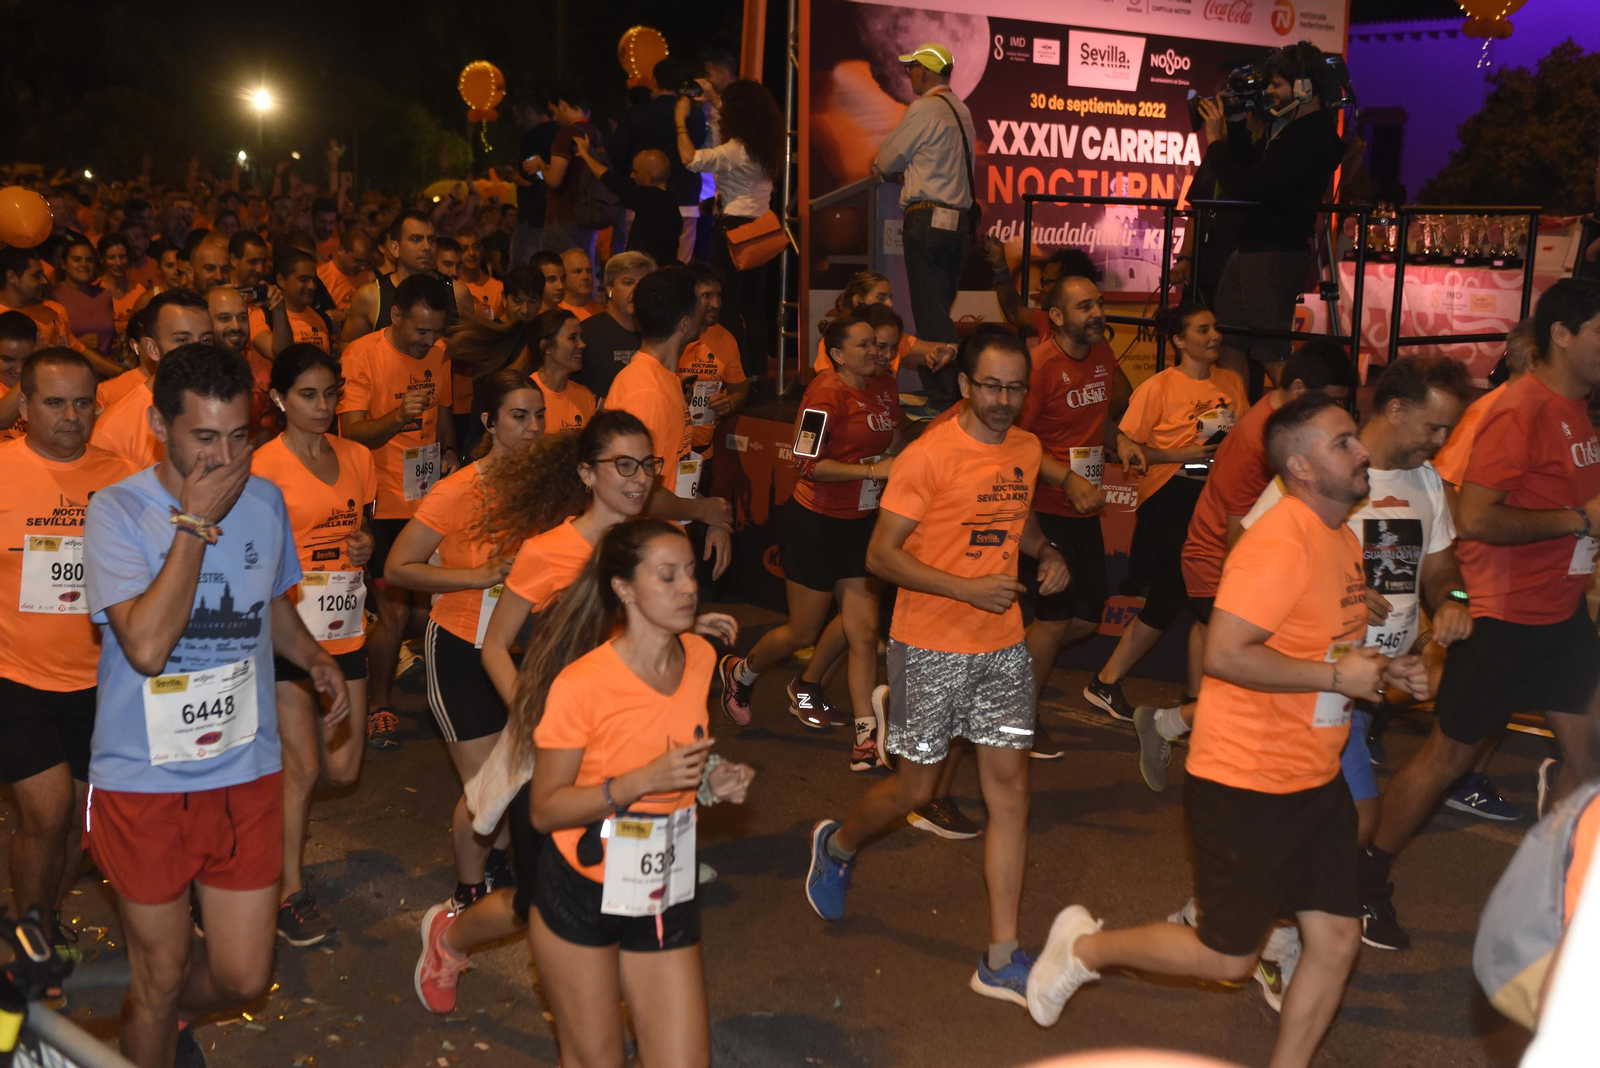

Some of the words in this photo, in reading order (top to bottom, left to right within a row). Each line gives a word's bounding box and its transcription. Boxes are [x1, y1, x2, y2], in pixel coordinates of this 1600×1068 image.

[1010, 36, 1026, 48] IMD
[1030, 93, 1045, 109] 30
[1048, 95, 1065, 111] de
[1066, 97, 1138, 118] septiembre
[1138, 101, 1167, 119] 2022
[987, 119, 1080, 159] XXXIV
[1081, 125, 1202, 167] CARRERA
[988, 220, 1017, 244] del
[1446, 291, 1463, 300] IMD
[407, 382, 436, 391] NOCTURNA
[692, 396, 709, 408] 605
[415, 461, 434, 478] 8469
[992, 484, 1029, 492] NOCTURNA
[977, 494, 1011, 503] SEVILLA
[1012, 492, 1029, 501] KH7
[26, 517, 77, 527] SEVILLA
[317, 594, 358, 612] 12063
[1374, 630, 1409, 650] 5467
[182, 694, 236, 725] 6448
